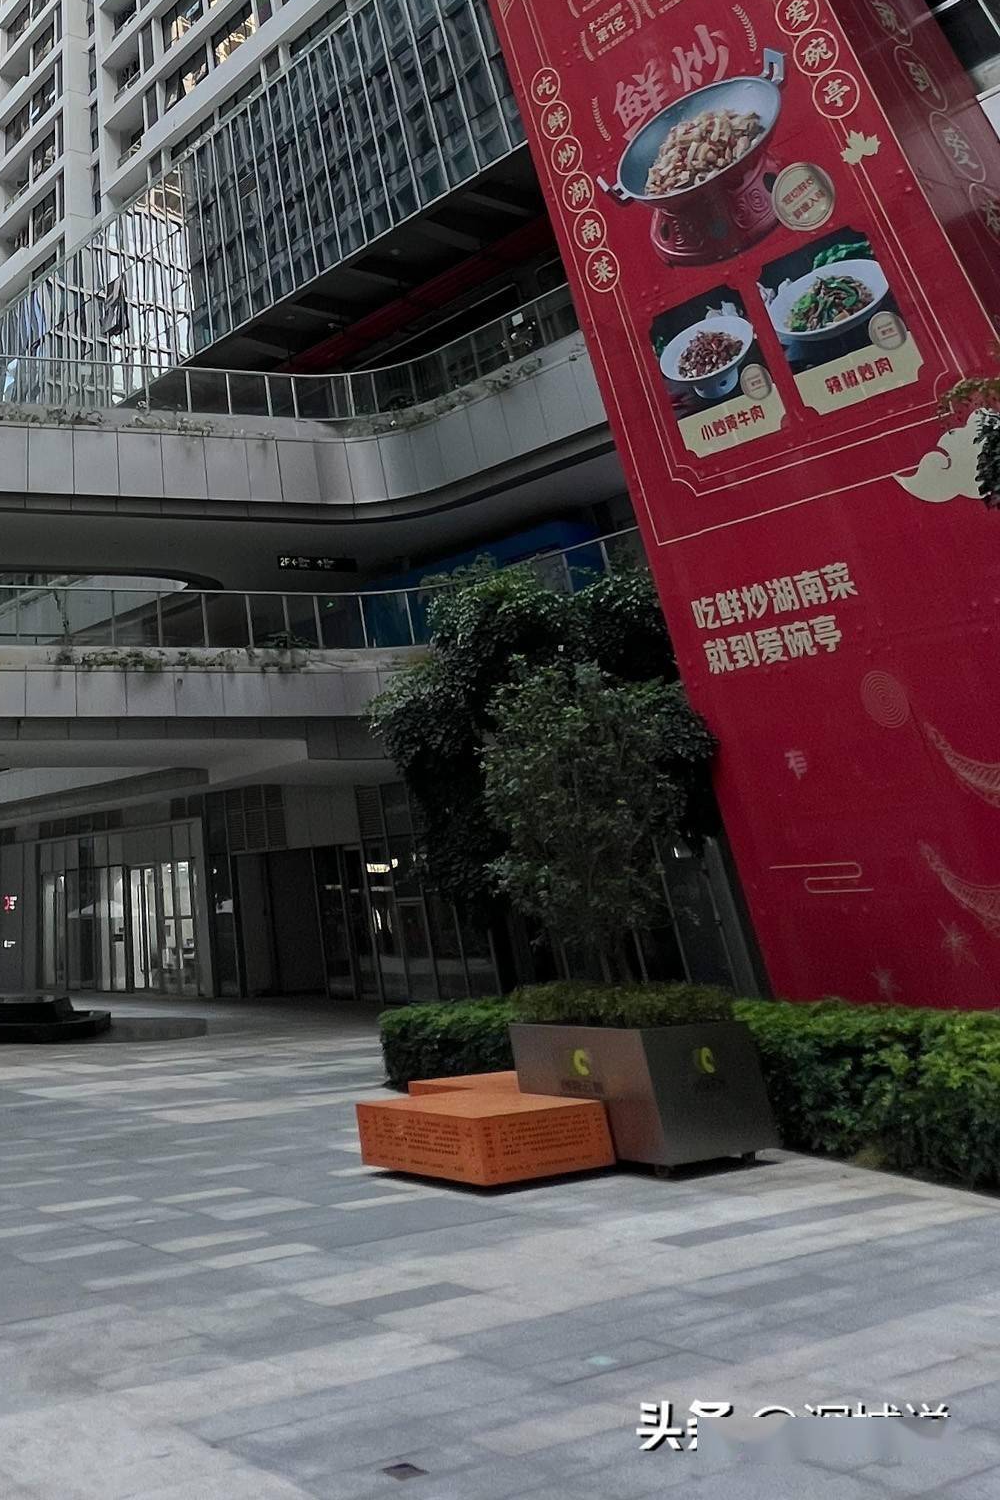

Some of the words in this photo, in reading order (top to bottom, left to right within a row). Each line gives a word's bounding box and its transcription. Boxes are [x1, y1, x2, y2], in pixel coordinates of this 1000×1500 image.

[595, 15, 627, 43] 第1名
[612, 24, 730, 141] 鲜炒
[536, 75, 616, 286] 吃鲜炒湖南菜
[280, 557, 291, 567] 2F
[690, 561, 859, 630] 吃鲜炒湖南菜
[702, 614, 843, 675] 就到爱碗亭
